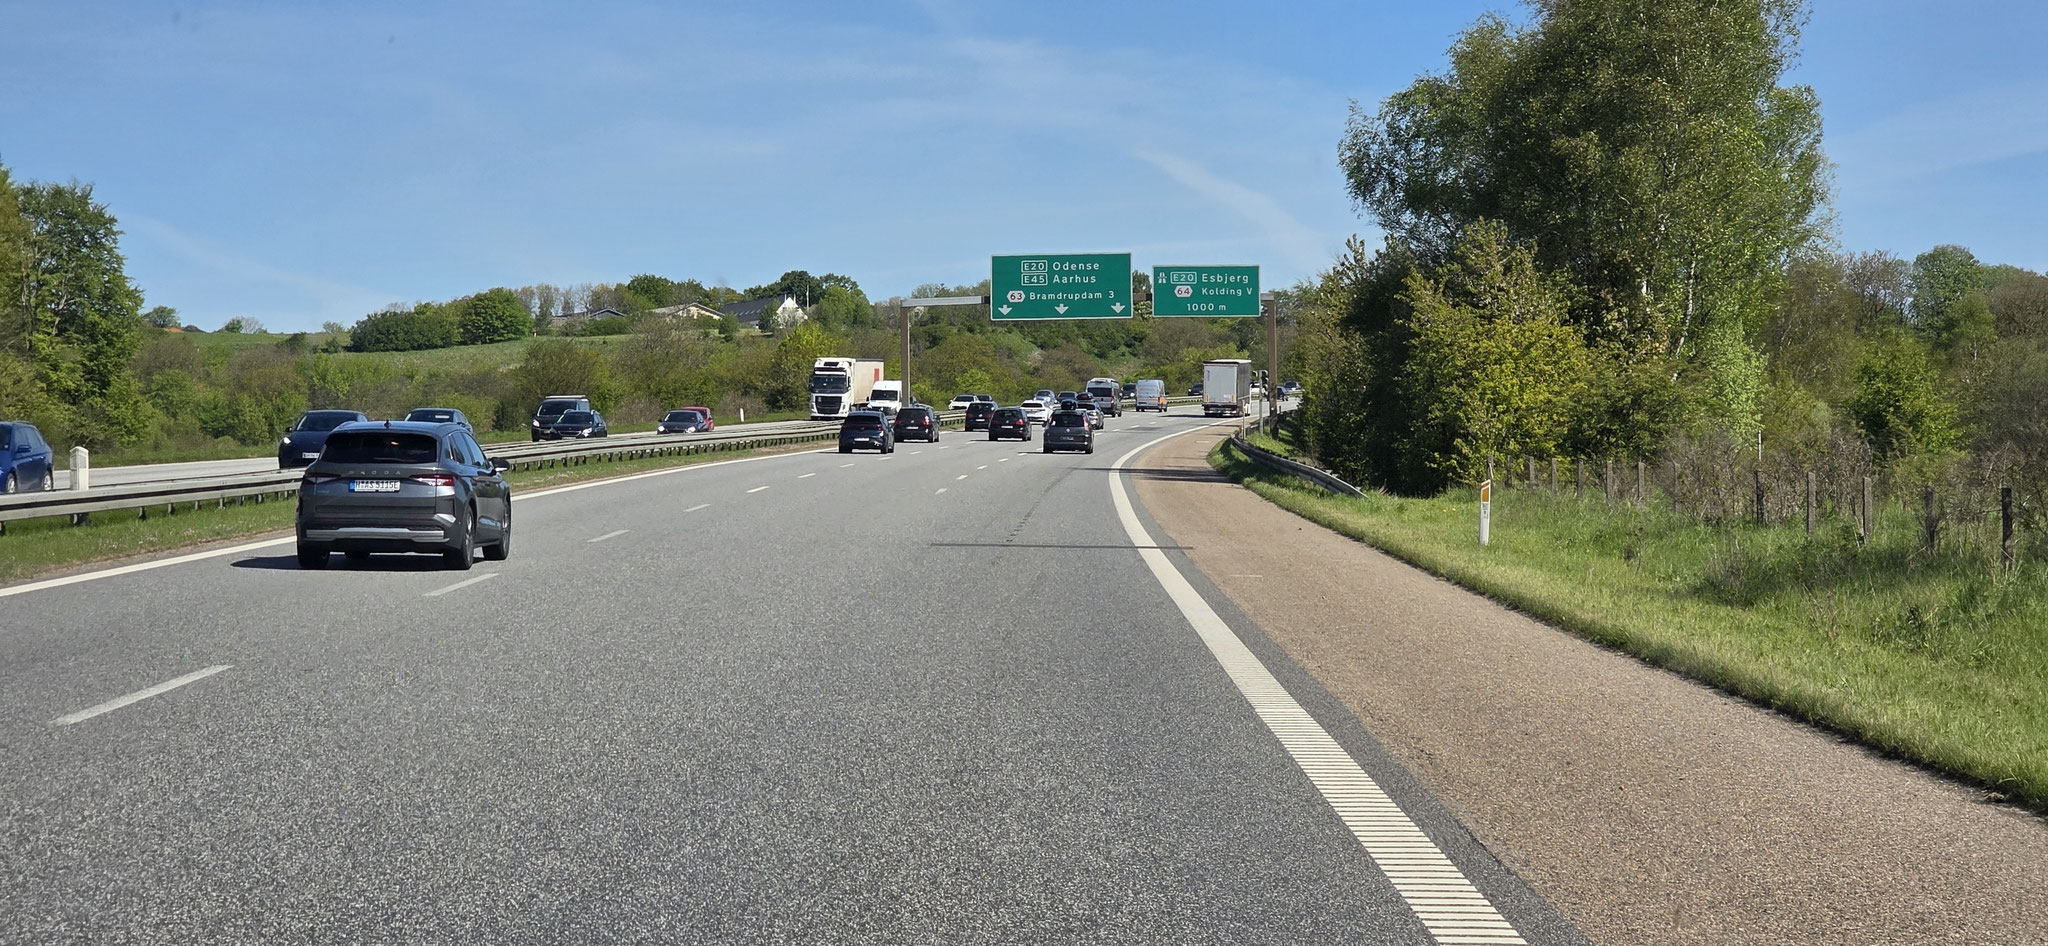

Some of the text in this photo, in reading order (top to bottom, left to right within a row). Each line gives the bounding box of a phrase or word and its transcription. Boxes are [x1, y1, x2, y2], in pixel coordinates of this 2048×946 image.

[1024, 261, 1100, 271] E20 Odense
[1024, 274, 1097, 284] E45 Aarhus
[1173, 273, 1249, 284] E20 Esbjerg
[1010, 290, 1115, 301] 63 Bramdrupdam 3
[1177, 287, 1253, 297] 64 Kolding V
[1187, 303, 1215, 311] 1000
